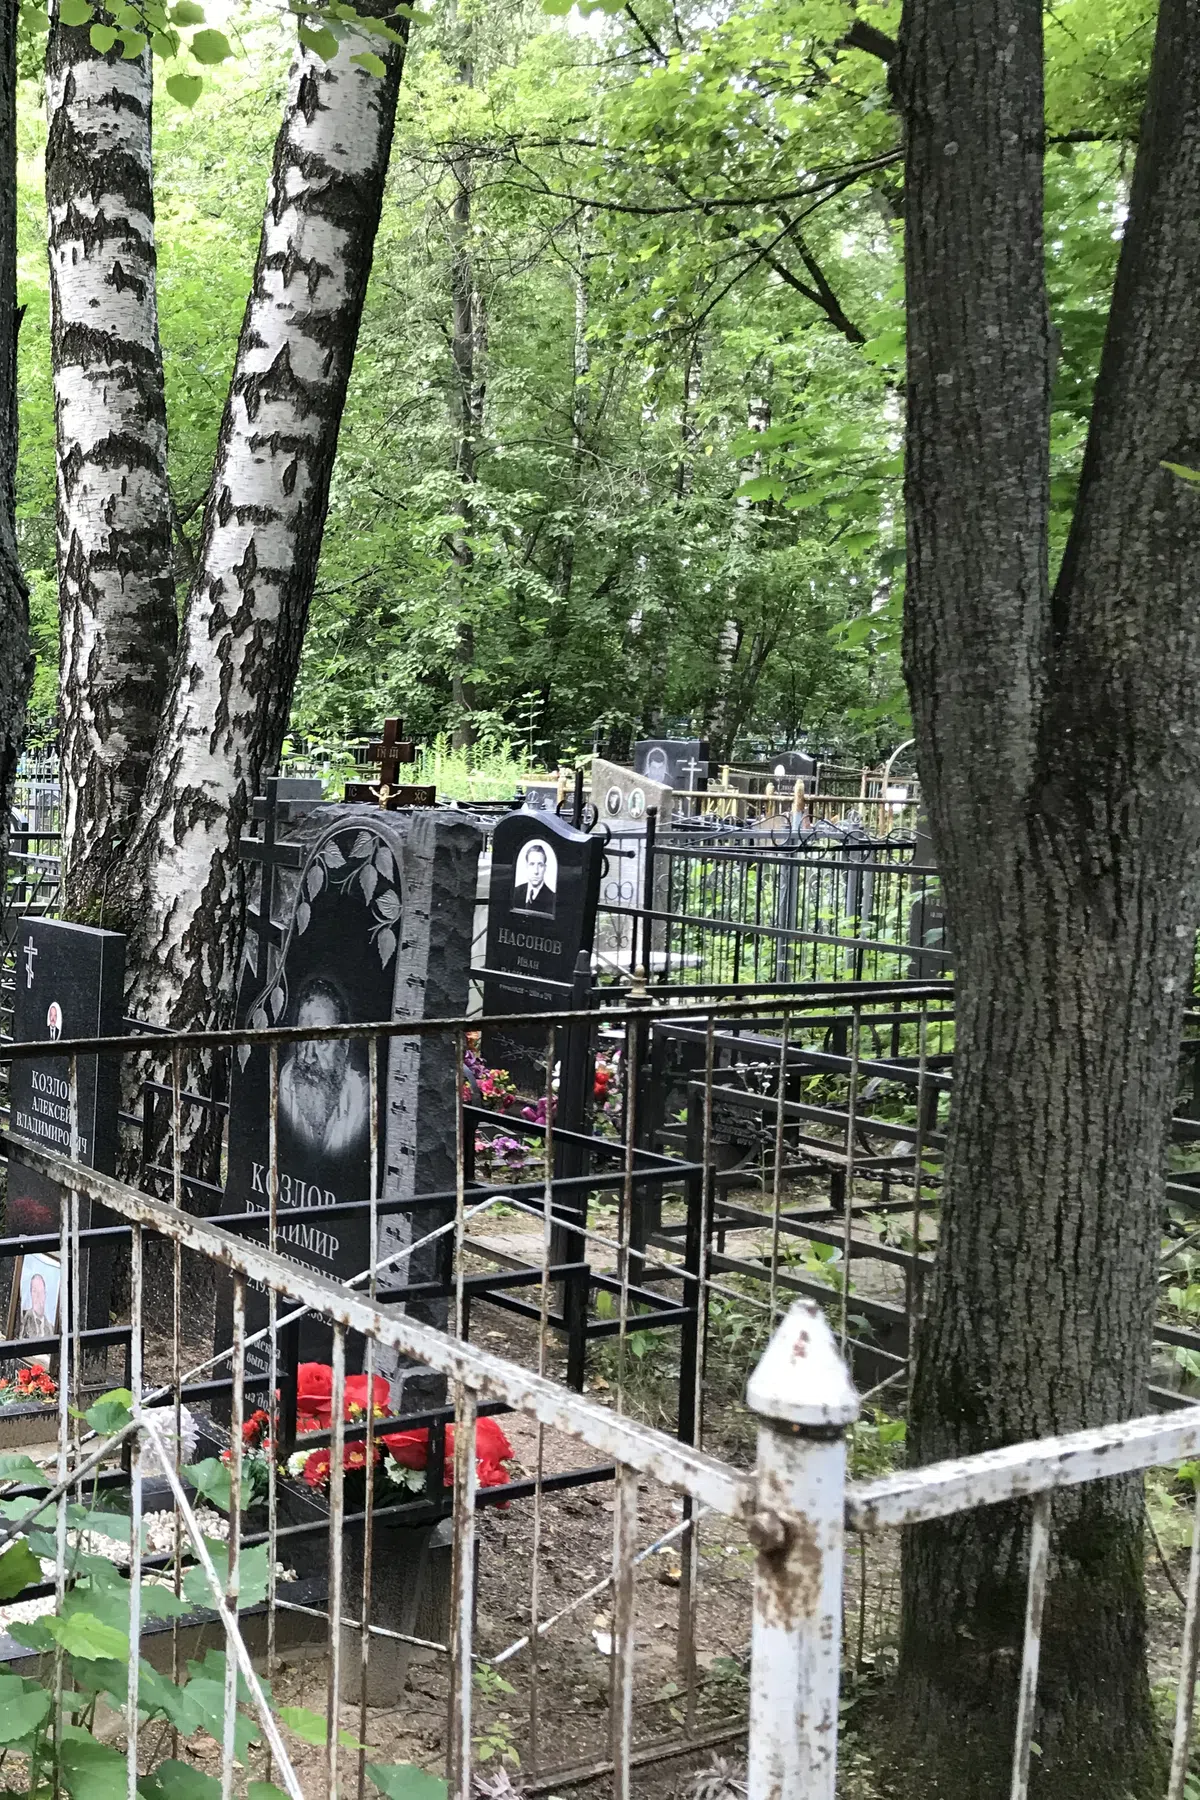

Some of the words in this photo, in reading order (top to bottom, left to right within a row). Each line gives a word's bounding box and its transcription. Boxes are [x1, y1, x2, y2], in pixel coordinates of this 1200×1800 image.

[497, 927, 563, 955] НАСОНОВ
[31, 1070, 71, 1102] КОЗЛО
[16, 1111, 87, 1154] ВЛАДИМИРОЧ
